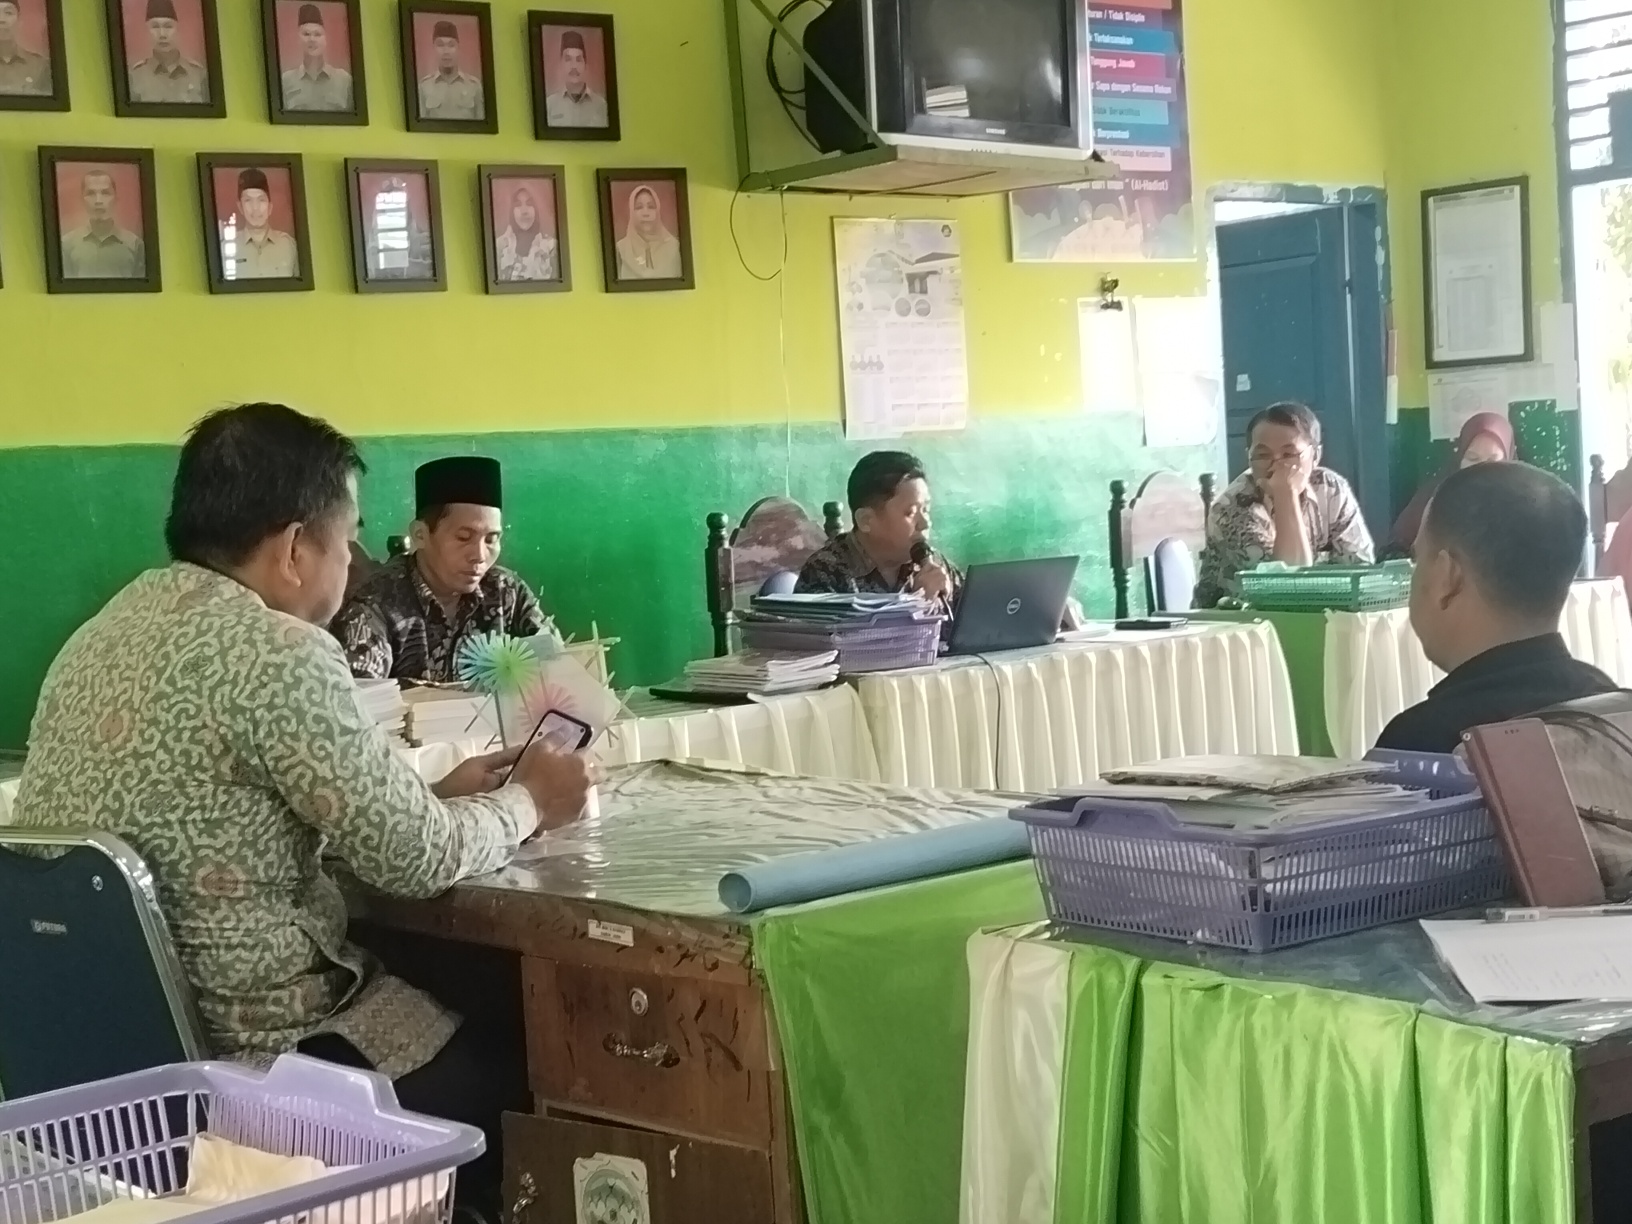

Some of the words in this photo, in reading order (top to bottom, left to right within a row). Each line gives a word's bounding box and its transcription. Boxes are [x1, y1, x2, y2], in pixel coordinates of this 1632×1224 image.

[1108, 10, 1124, 21] Tidak
[1125, 11, 1145, 23] Disiplin
[1118, 58, 1136, 69] Jawab
[1111, 82, 1131, 93] dengan
[1110, 149, 1135, 158] Terhadap
[1131, 179, 1169, 191] (Al-Hadist)
